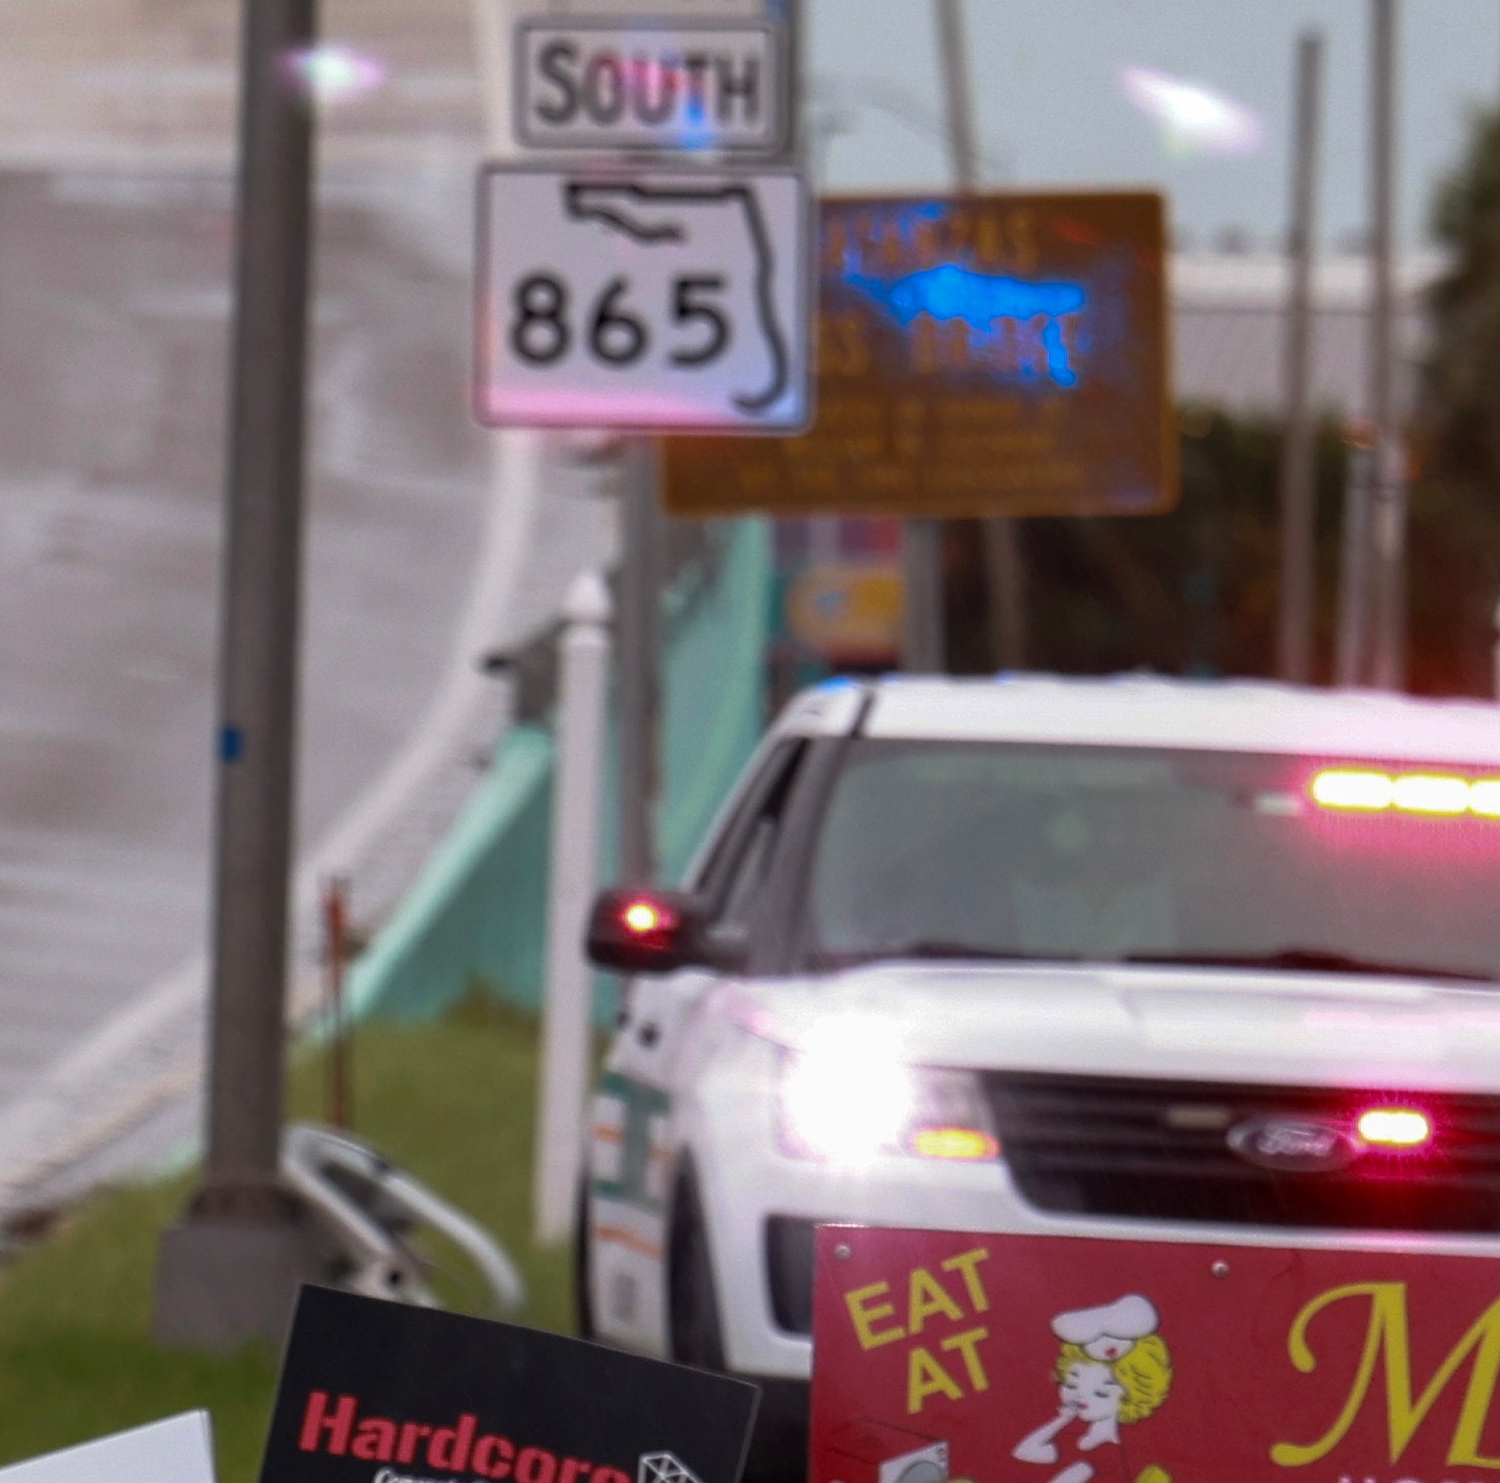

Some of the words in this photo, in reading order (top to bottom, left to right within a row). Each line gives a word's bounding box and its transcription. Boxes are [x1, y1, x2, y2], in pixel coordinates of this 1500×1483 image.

[533, 39, 761, 129] SOUTH
[510, 268, 731, 368] 865
[844, 1247, 990, 1351] EAT
[906, 1326, 990, 1416] AT
